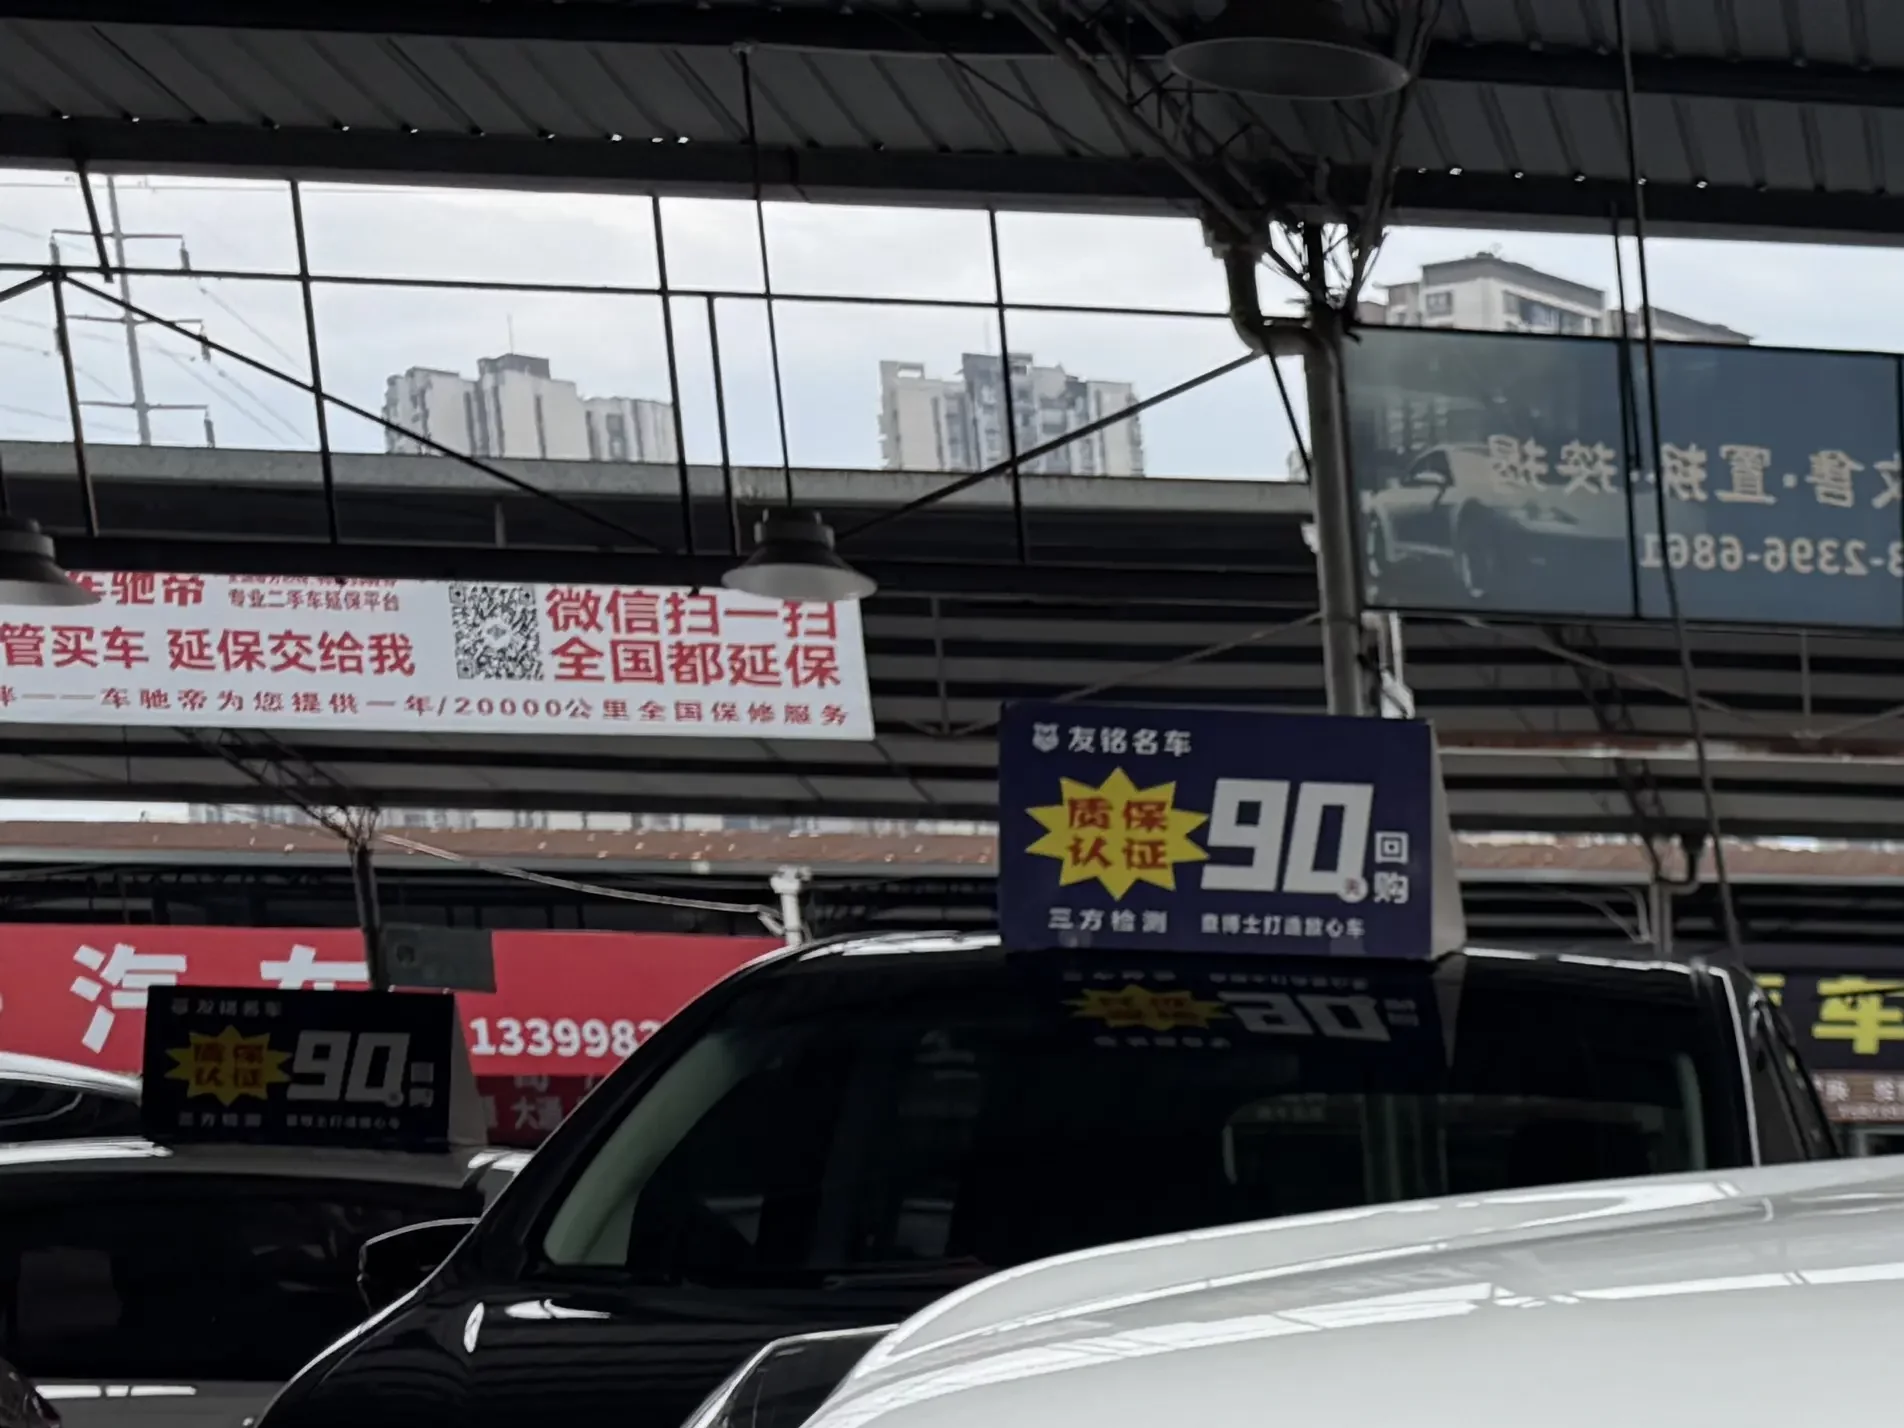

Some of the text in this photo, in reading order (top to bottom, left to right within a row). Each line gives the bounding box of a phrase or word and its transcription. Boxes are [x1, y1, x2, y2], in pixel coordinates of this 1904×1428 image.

[545, 587, 838, 640] 微信扫一扫
[0, 622, 416, 677] 管买车 延保交给我
[550, 637, 841, 690] 全国都延保
[1067, 726, 1193, 758] 友铭名车
[1067, 796, 1169, 831] 质保
[1200, 777, 1374, 894] 90
[1067, 835, 1169, 871] 认证
[1373, 830, 1410, 904] 回购
[1047, 908, 1168, 934] 三方检测
[287, 1030, 411, 1102] 90
